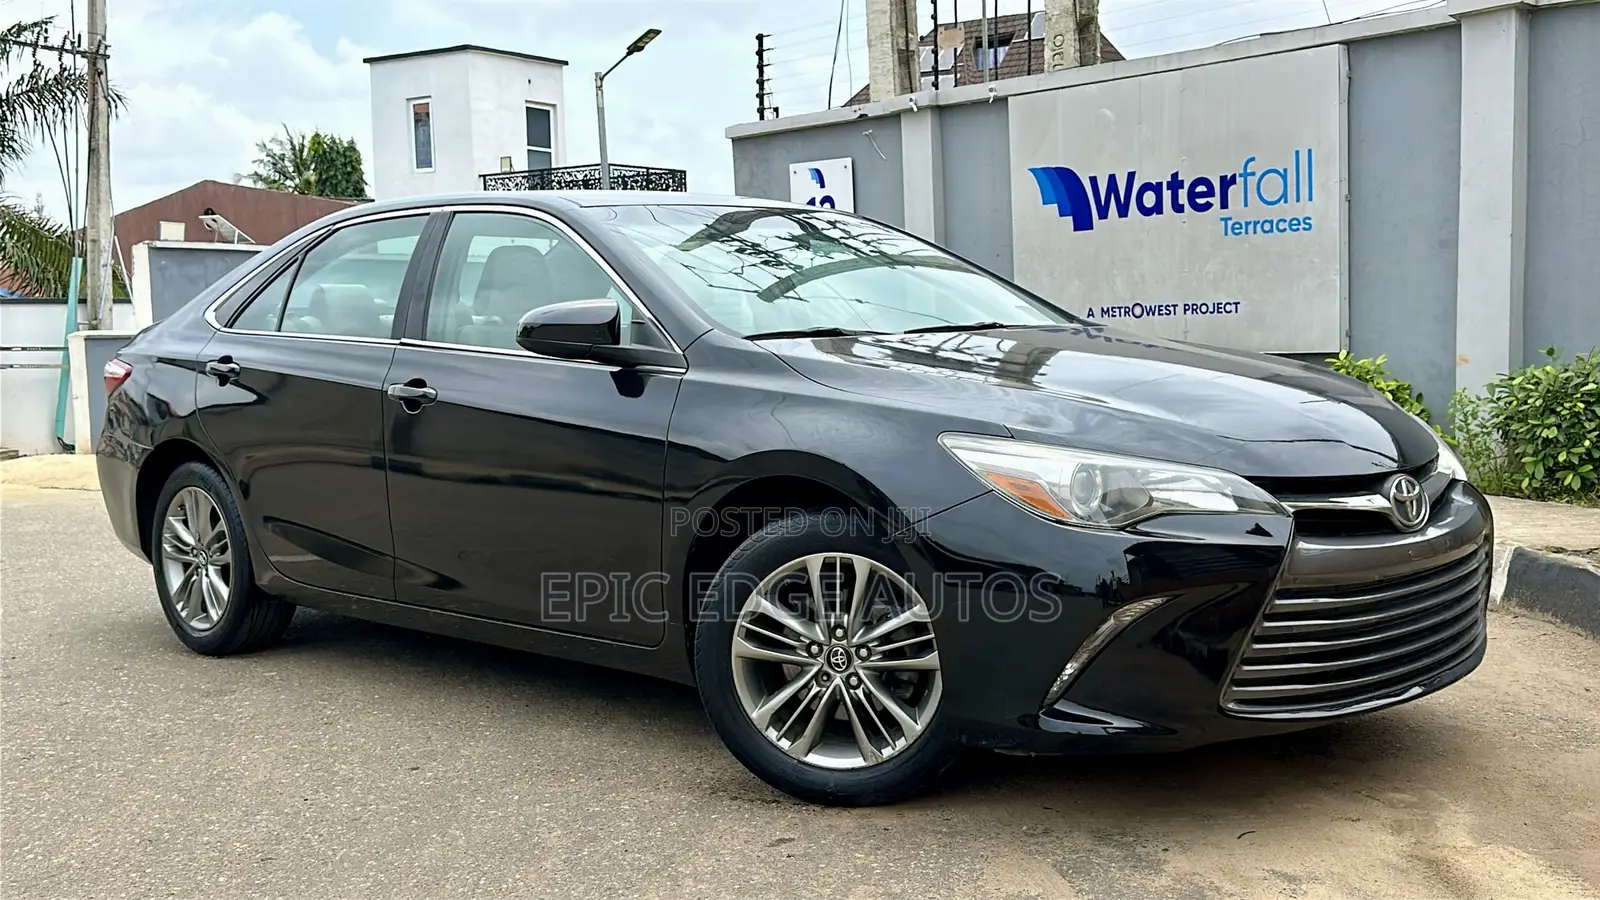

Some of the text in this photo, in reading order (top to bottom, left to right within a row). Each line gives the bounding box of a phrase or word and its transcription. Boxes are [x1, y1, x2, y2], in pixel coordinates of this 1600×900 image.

[1088, 148, 1313, 221] Waterfall
[1219, 216, 1312, 236] Terraces
[1086, 301, 1241, 319] A METROWEST PROJECT
